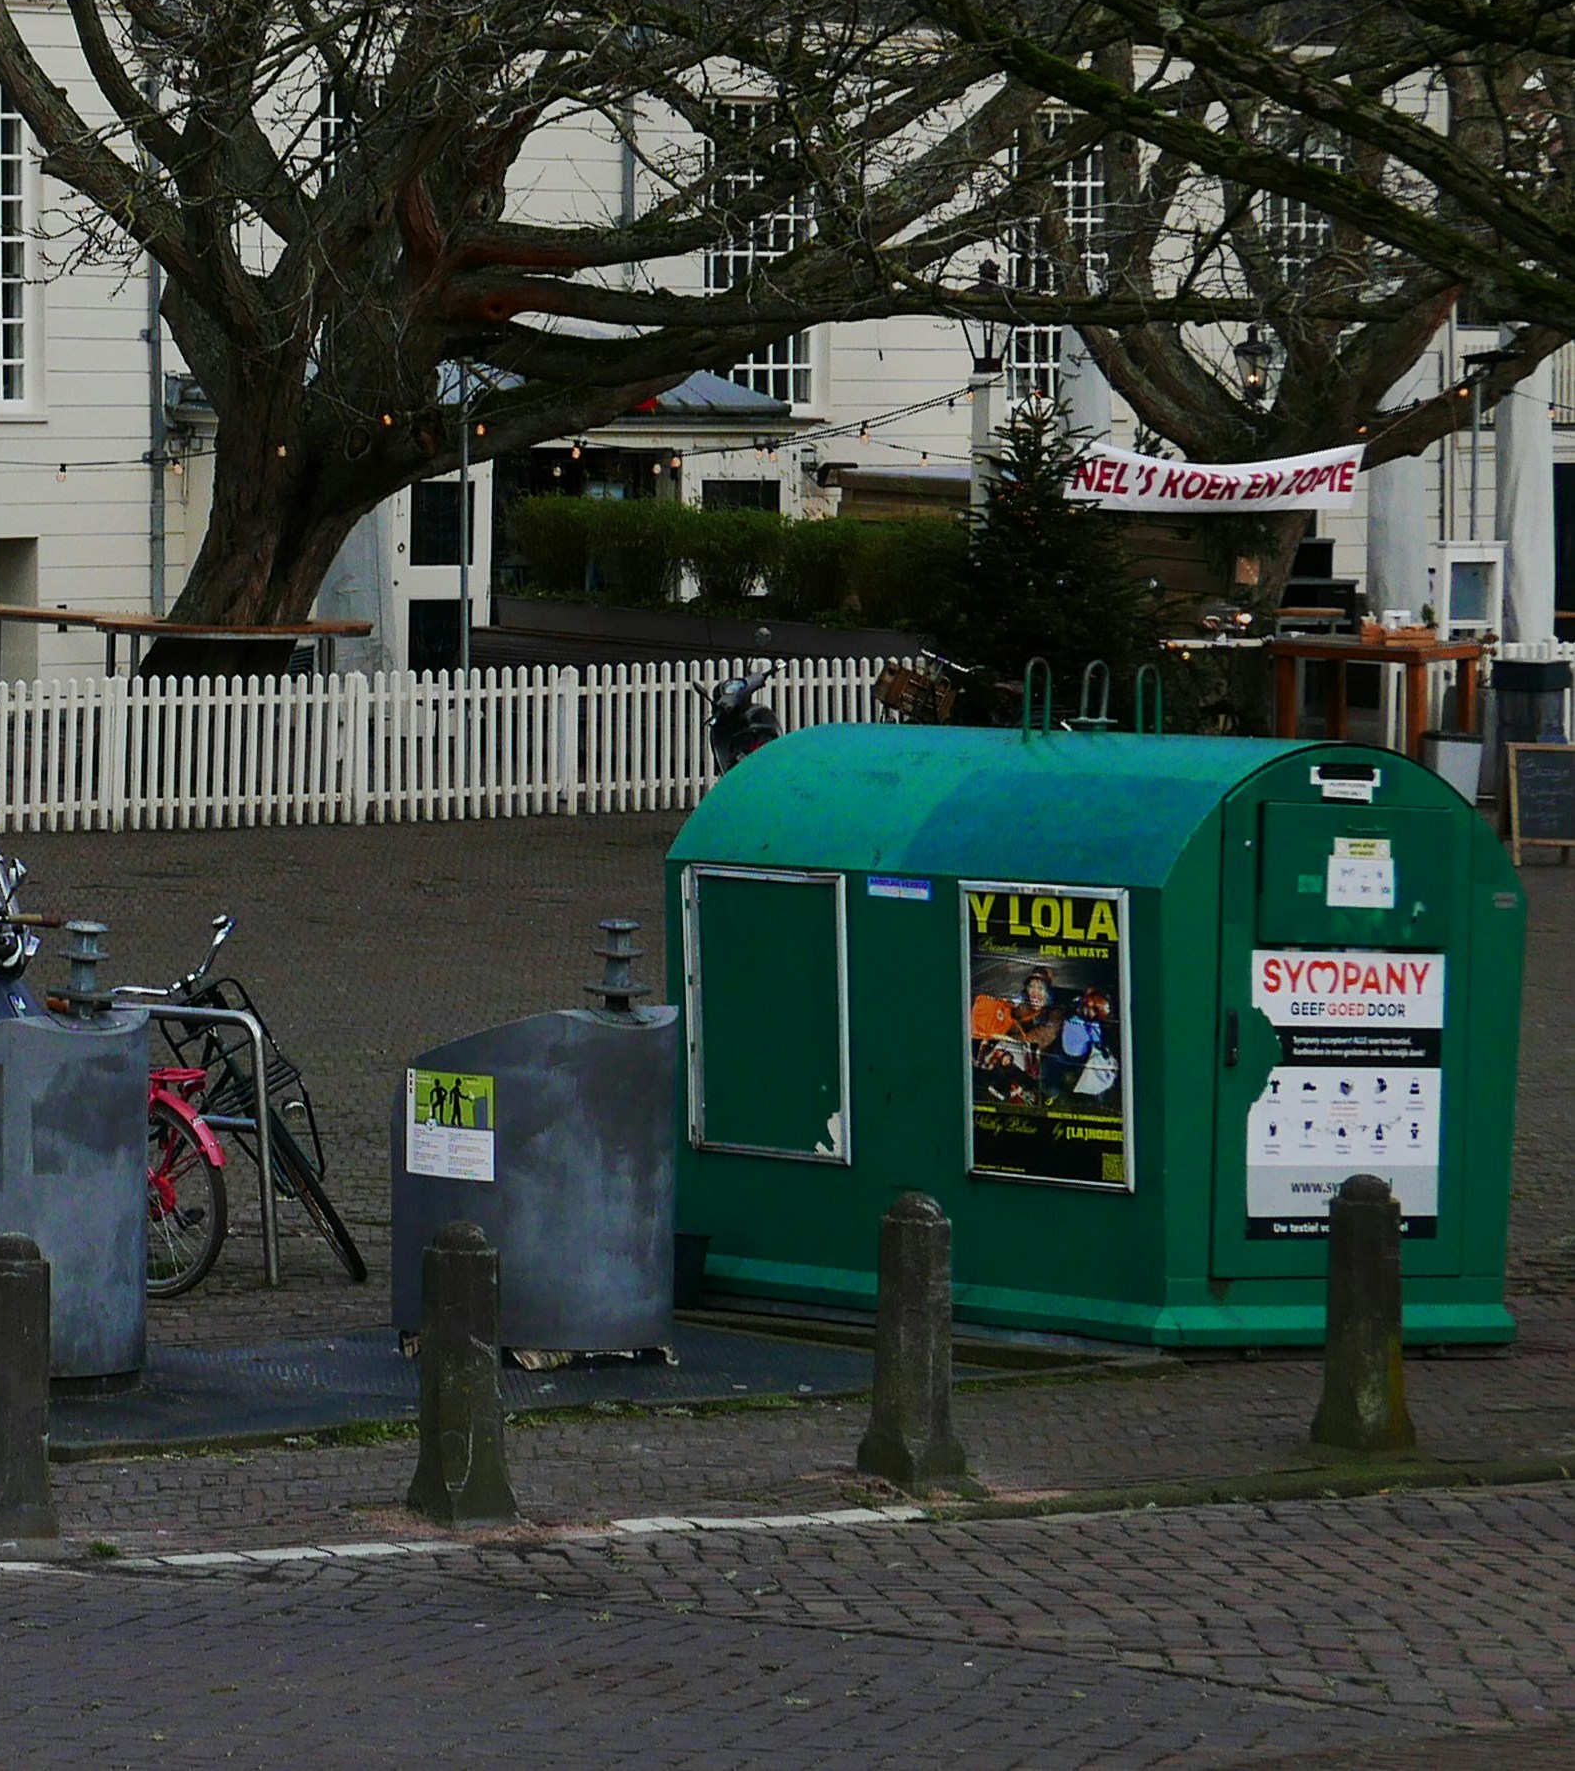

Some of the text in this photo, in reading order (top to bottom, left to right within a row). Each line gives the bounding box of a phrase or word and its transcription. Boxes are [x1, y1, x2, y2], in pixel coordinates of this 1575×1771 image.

[1241, 470, 1284, 500] EN
[1281, 460, 1356, 495] ZOPIE
[969, 893, 1120, 941] Y LOLA
[1067, 946, 1109, 959] ALWAYS
[1291, 1001, 1406, 1017] GEEF GOED DOOR
[1290, 1222, 1319, 1233] textiel
